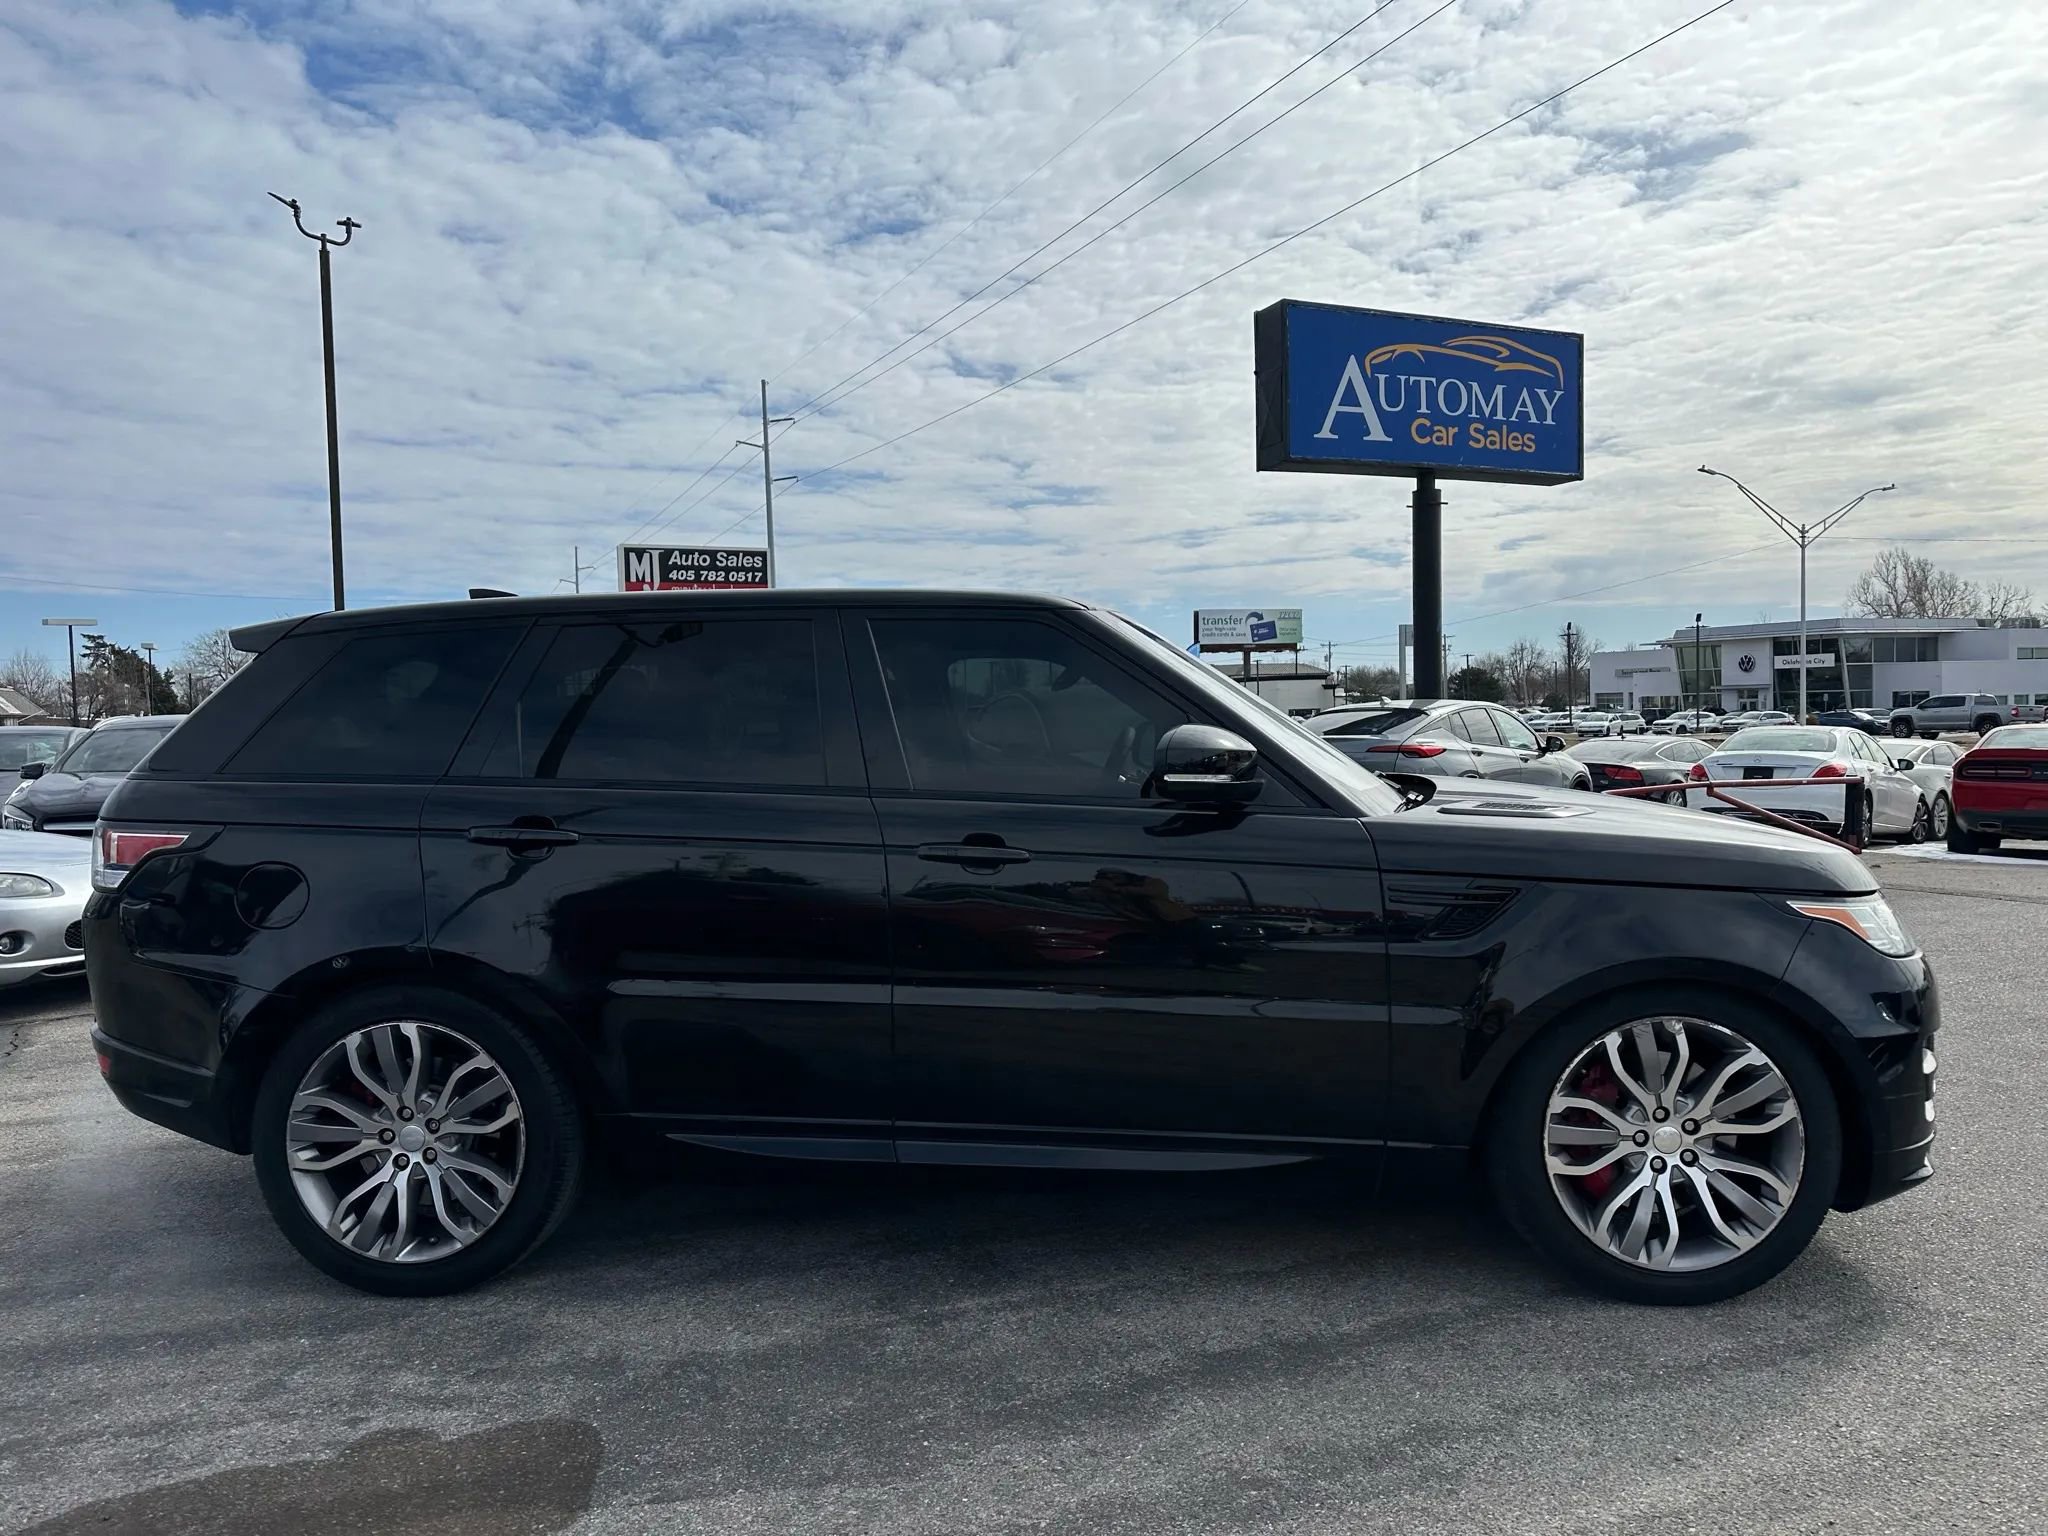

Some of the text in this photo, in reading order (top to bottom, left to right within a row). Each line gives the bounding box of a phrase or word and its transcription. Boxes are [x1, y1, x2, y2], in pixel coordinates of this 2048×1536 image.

[1313, 354, 1565, 442] AUTOMAY
[1410, 417, 1536, 453] Car Sales
[668, 550, 763, 568] Auto Sales
[668, 569, 763, 583] 405 782 0517
[1202, 614, 1243, 625] transfer
[1813, 657, 1826, 665] City
